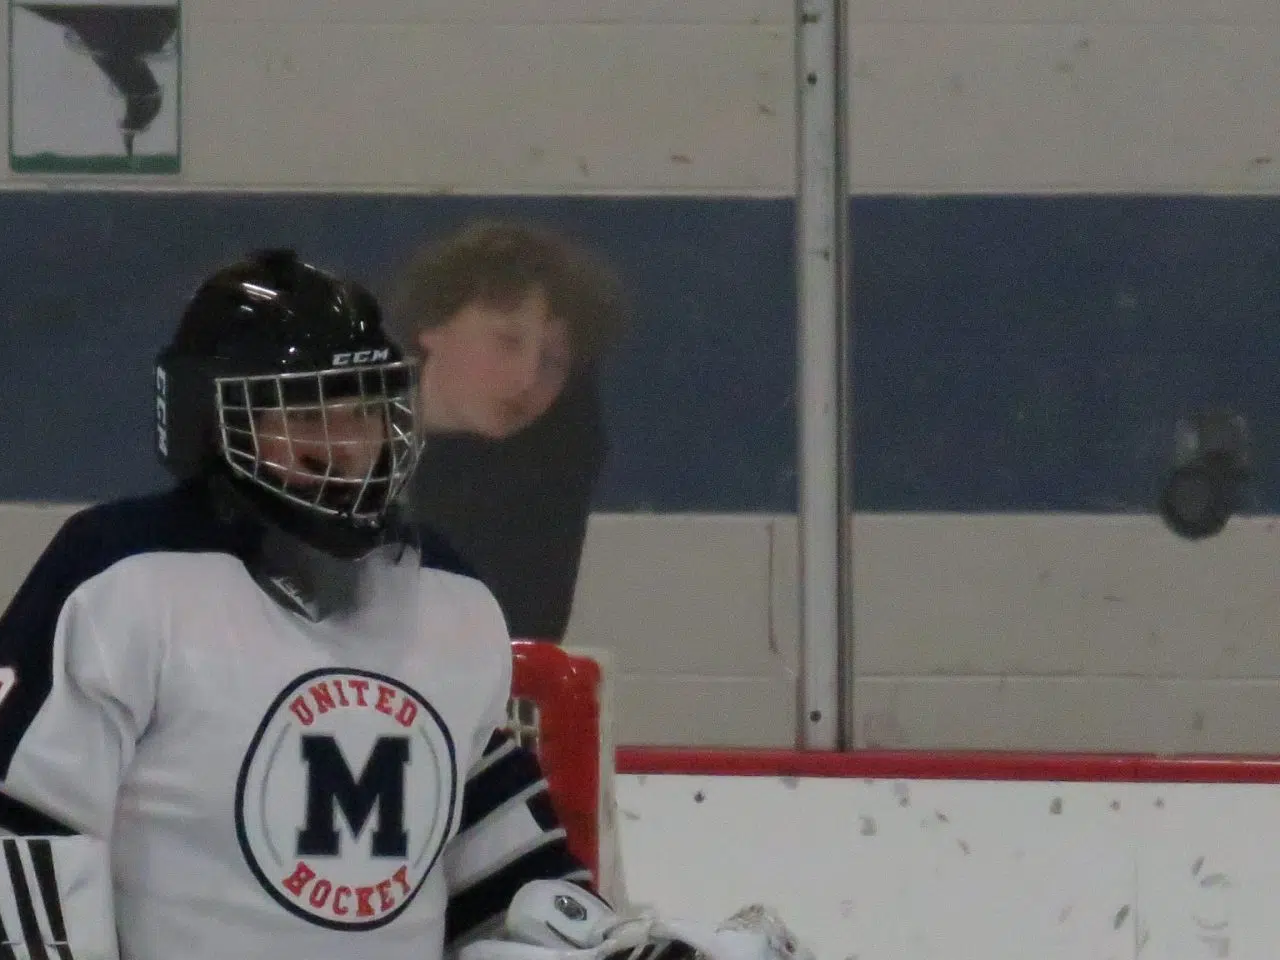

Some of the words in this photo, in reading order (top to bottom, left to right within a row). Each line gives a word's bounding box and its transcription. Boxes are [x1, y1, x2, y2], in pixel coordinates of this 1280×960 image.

[332, 349, 389, 366] CCM
[156, 366, 168, 456] CCM
[289, 680, 418, 727] UNITED
[294, 734, 411, 859] M
[282, 861, 411, 917] HOCKEY
